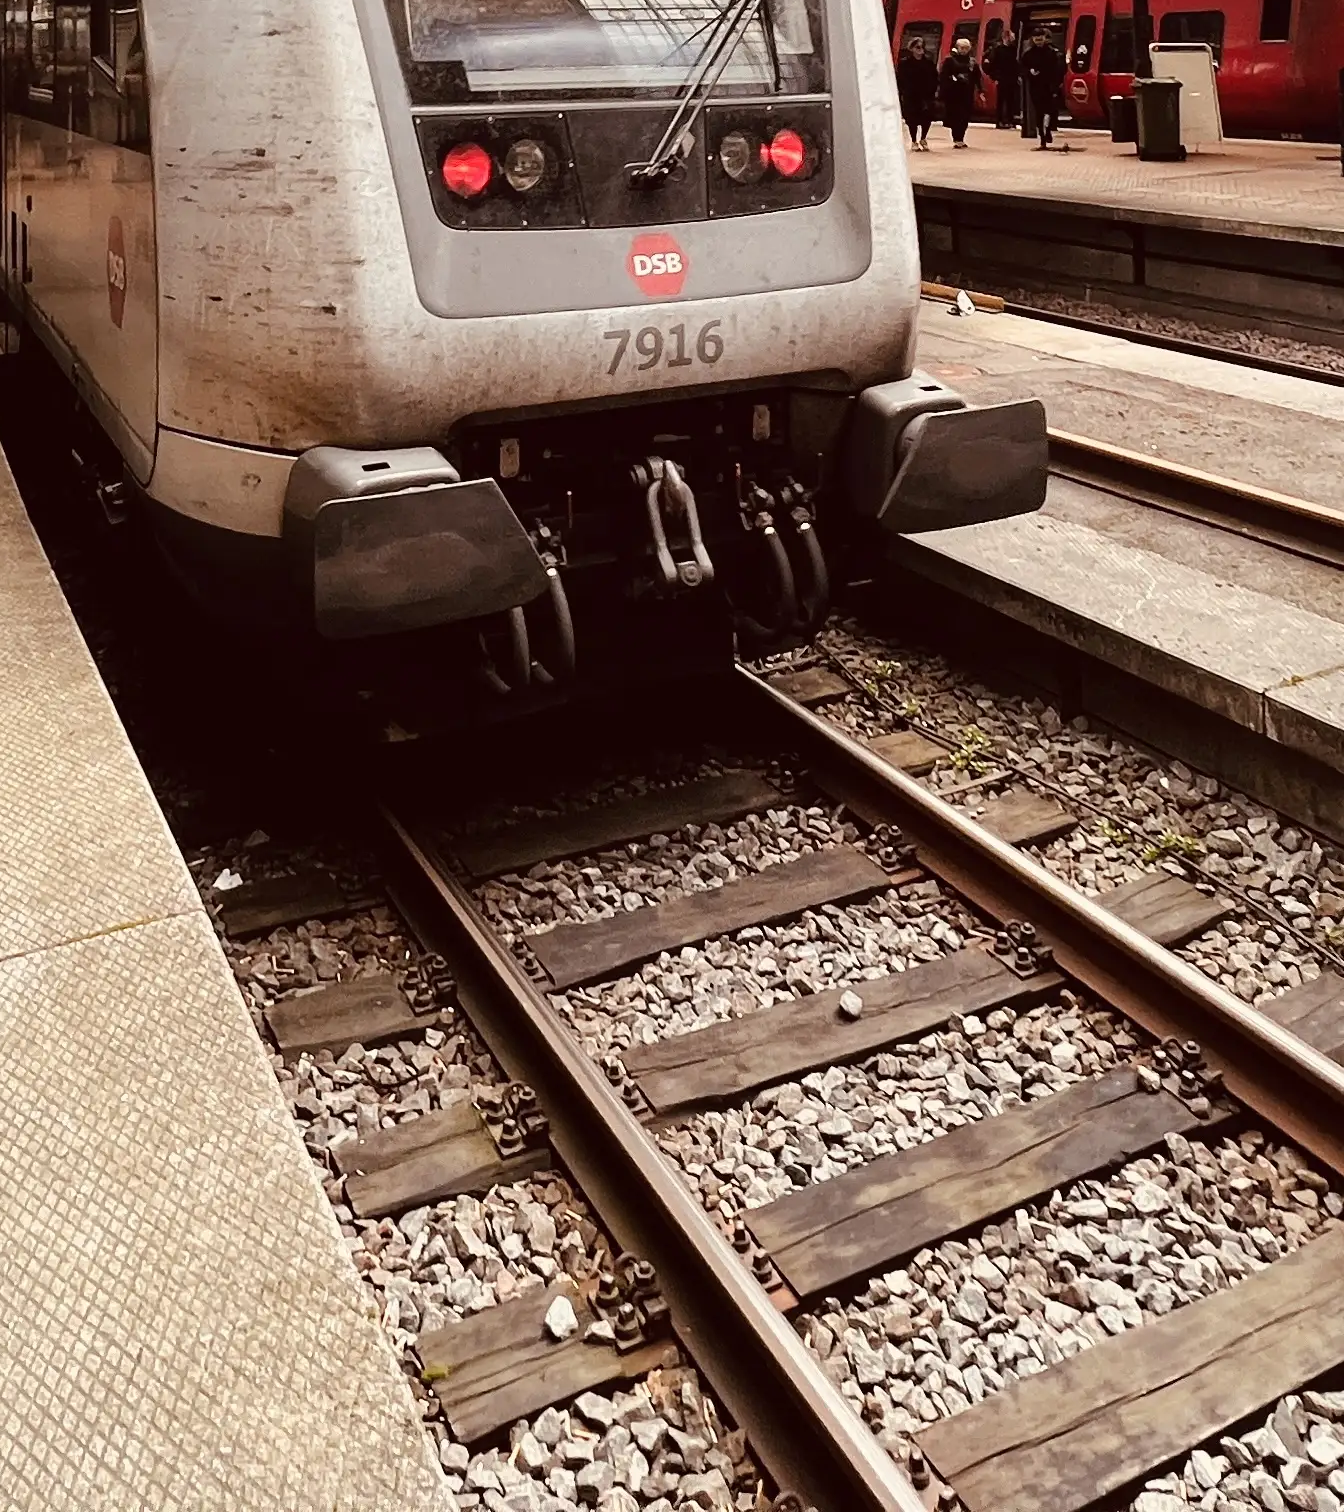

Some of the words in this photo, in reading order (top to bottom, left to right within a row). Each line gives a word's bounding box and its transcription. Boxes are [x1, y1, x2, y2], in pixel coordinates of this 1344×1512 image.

[108, 249, 125, 291] DSB
[632, 251, 684, 276] DSB
[603, 319, 725, 377] 7916
